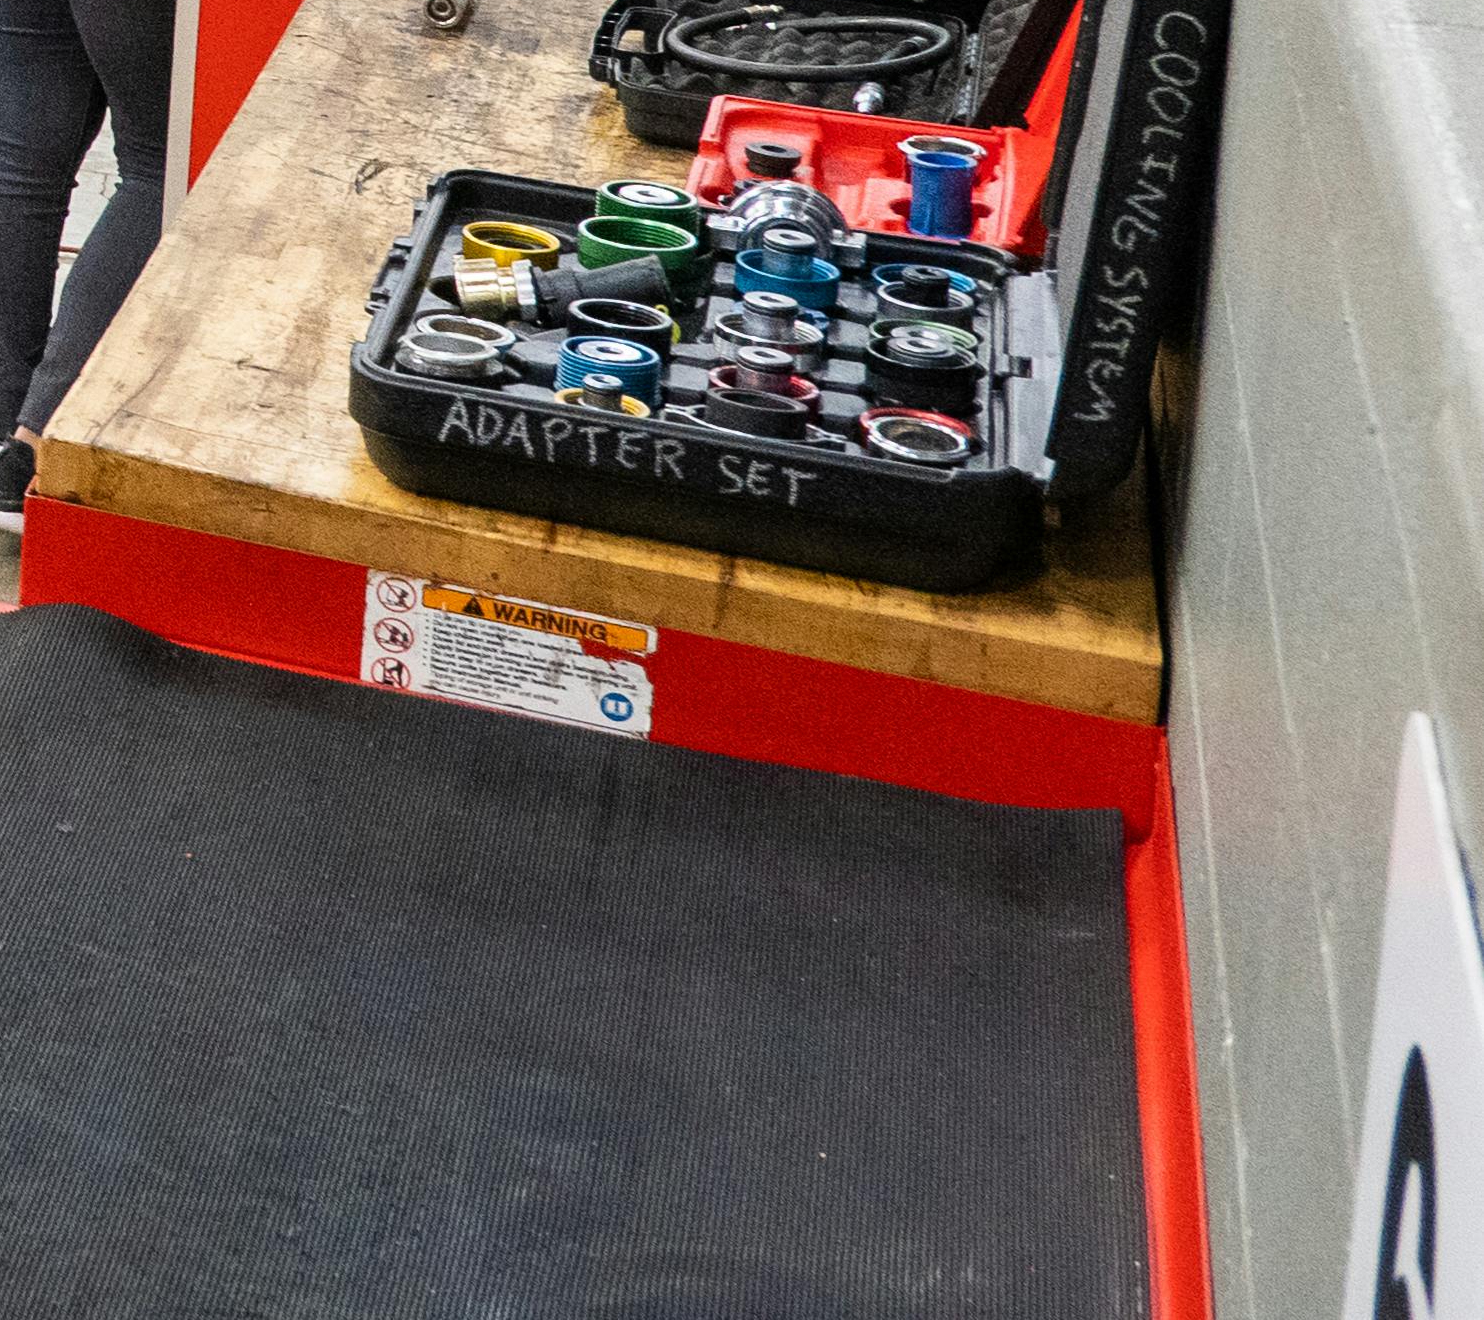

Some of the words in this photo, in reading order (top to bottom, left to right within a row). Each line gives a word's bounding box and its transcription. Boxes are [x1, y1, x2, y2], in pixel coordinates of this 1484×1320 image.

[1111, 11, 1207, 253] COOLING
[1073, 265, 1148, 423] SYSTEM
[437, 395, 686, 479] ADAPTER
[718, 454, 818, 506] SET
[493, 601, 608, 642] WARNING
